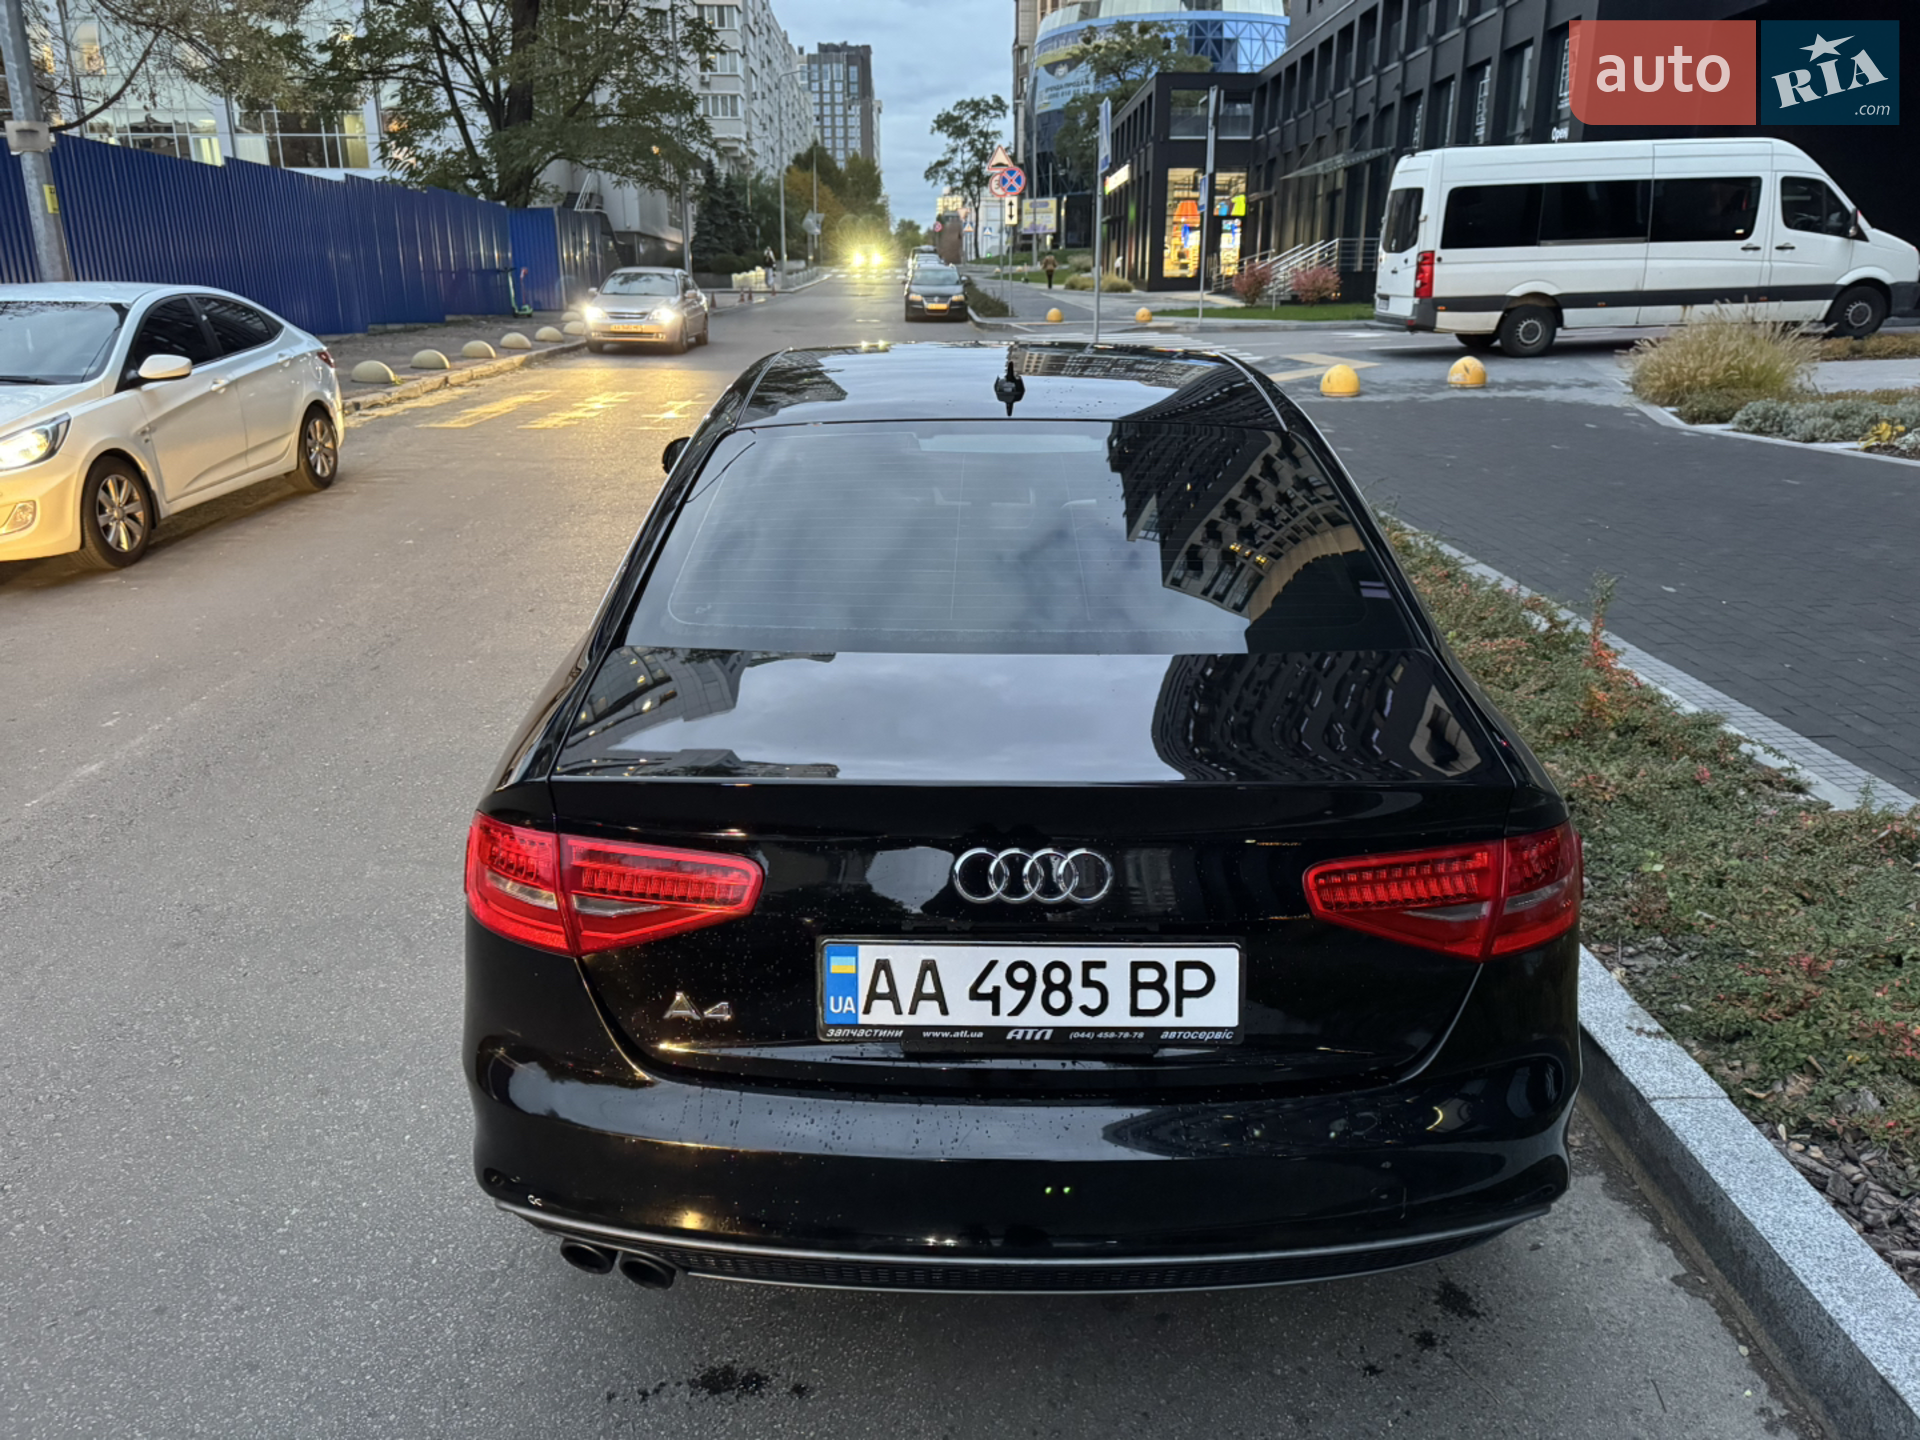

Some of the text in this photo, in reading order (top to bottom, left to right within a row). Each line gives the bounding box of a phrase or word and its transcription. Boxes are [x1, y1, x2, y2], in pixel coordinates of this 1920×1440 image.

[861, 959, 1217, 1018] AA 4985 BP
[663, 991, 733, 1021] A4
[829, 996, 857, 1014] UA
[922, 1030, 984, 1038] www.atl.ua
[1069, 1031, 1095, 1040] (044)
[1160, 1029, 1235, 1041] автосервіс
